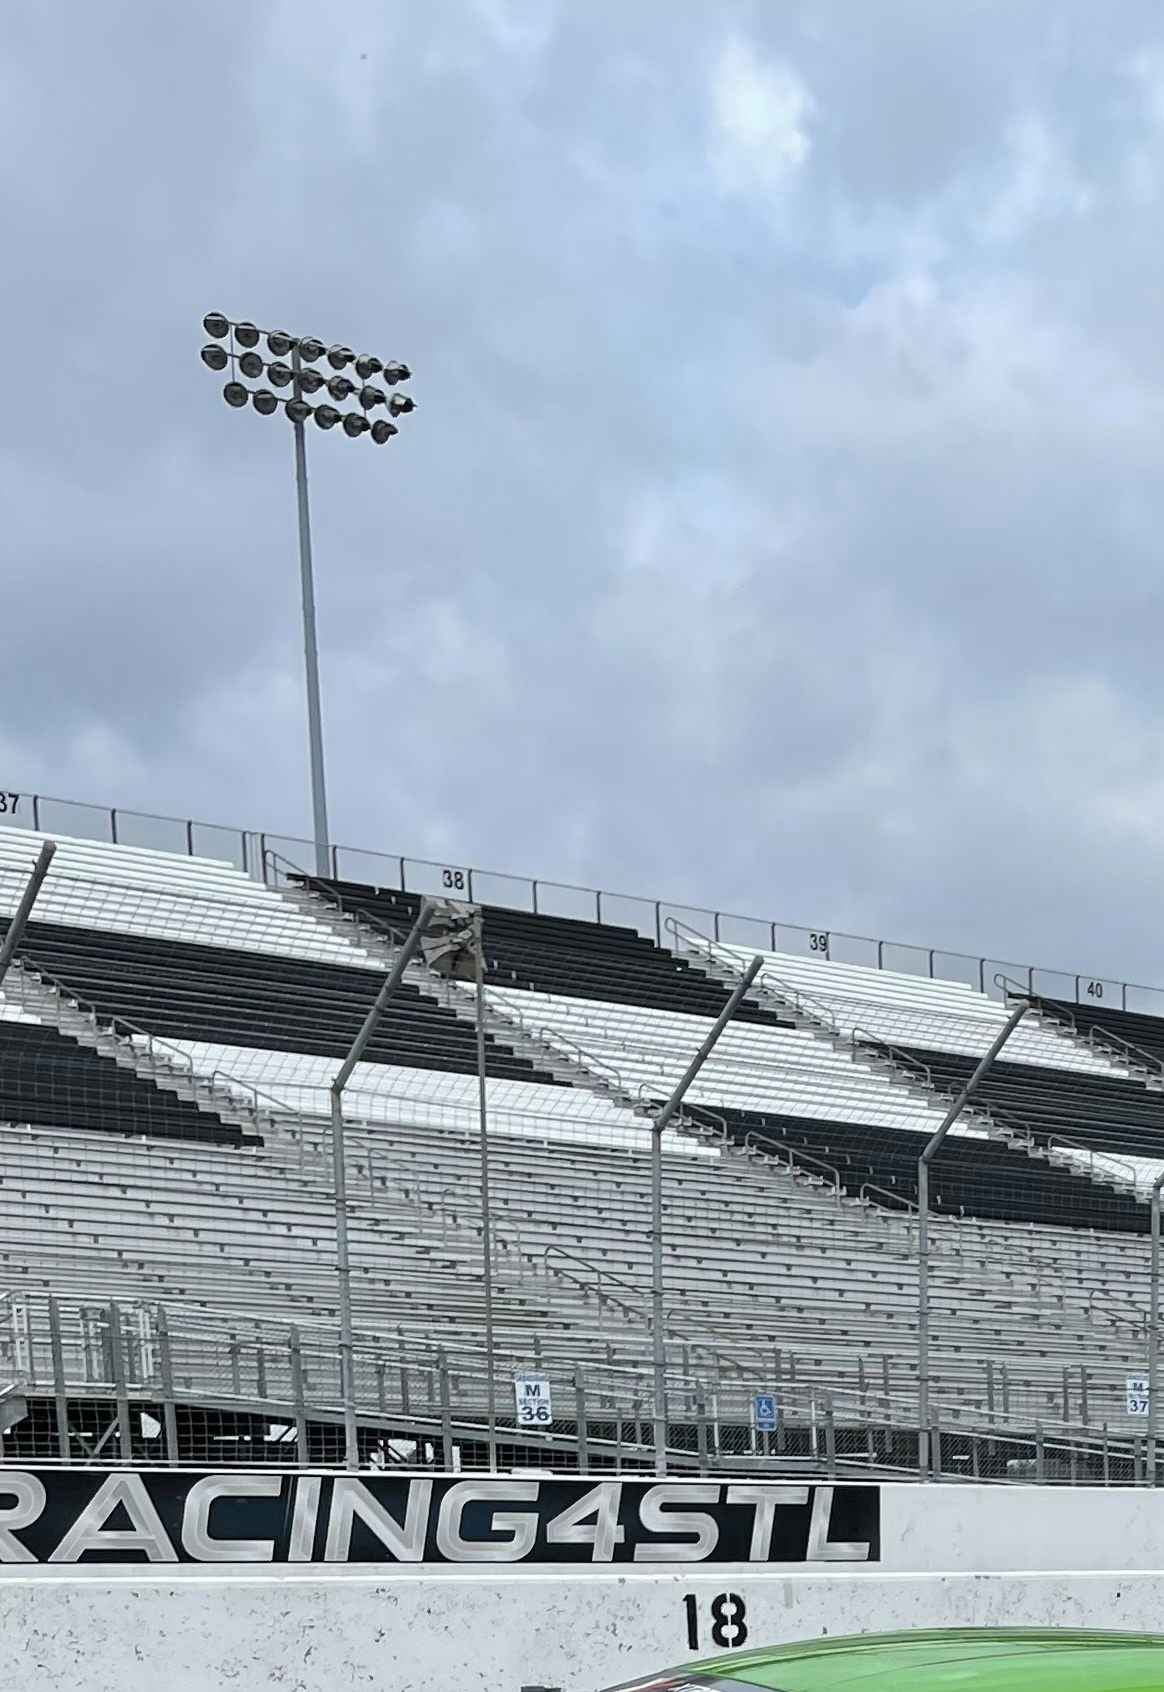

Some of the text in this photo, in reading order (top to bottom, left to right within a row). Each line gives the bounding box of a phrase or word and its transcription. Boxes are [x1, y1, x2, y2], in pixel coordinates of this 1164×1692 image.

[0, 791, 19, 814] 37
[443, 869, 464, 890] 38
[810, 933, 828, 951] 39
[1088, 981, 1103, 998] 40
[525, 1384, 541, 1396] M
[521, 1406, 550, 1421] 36
[1129, 1399, 1148, 1413] 37
[683, 1592, 748, 1650] 18
